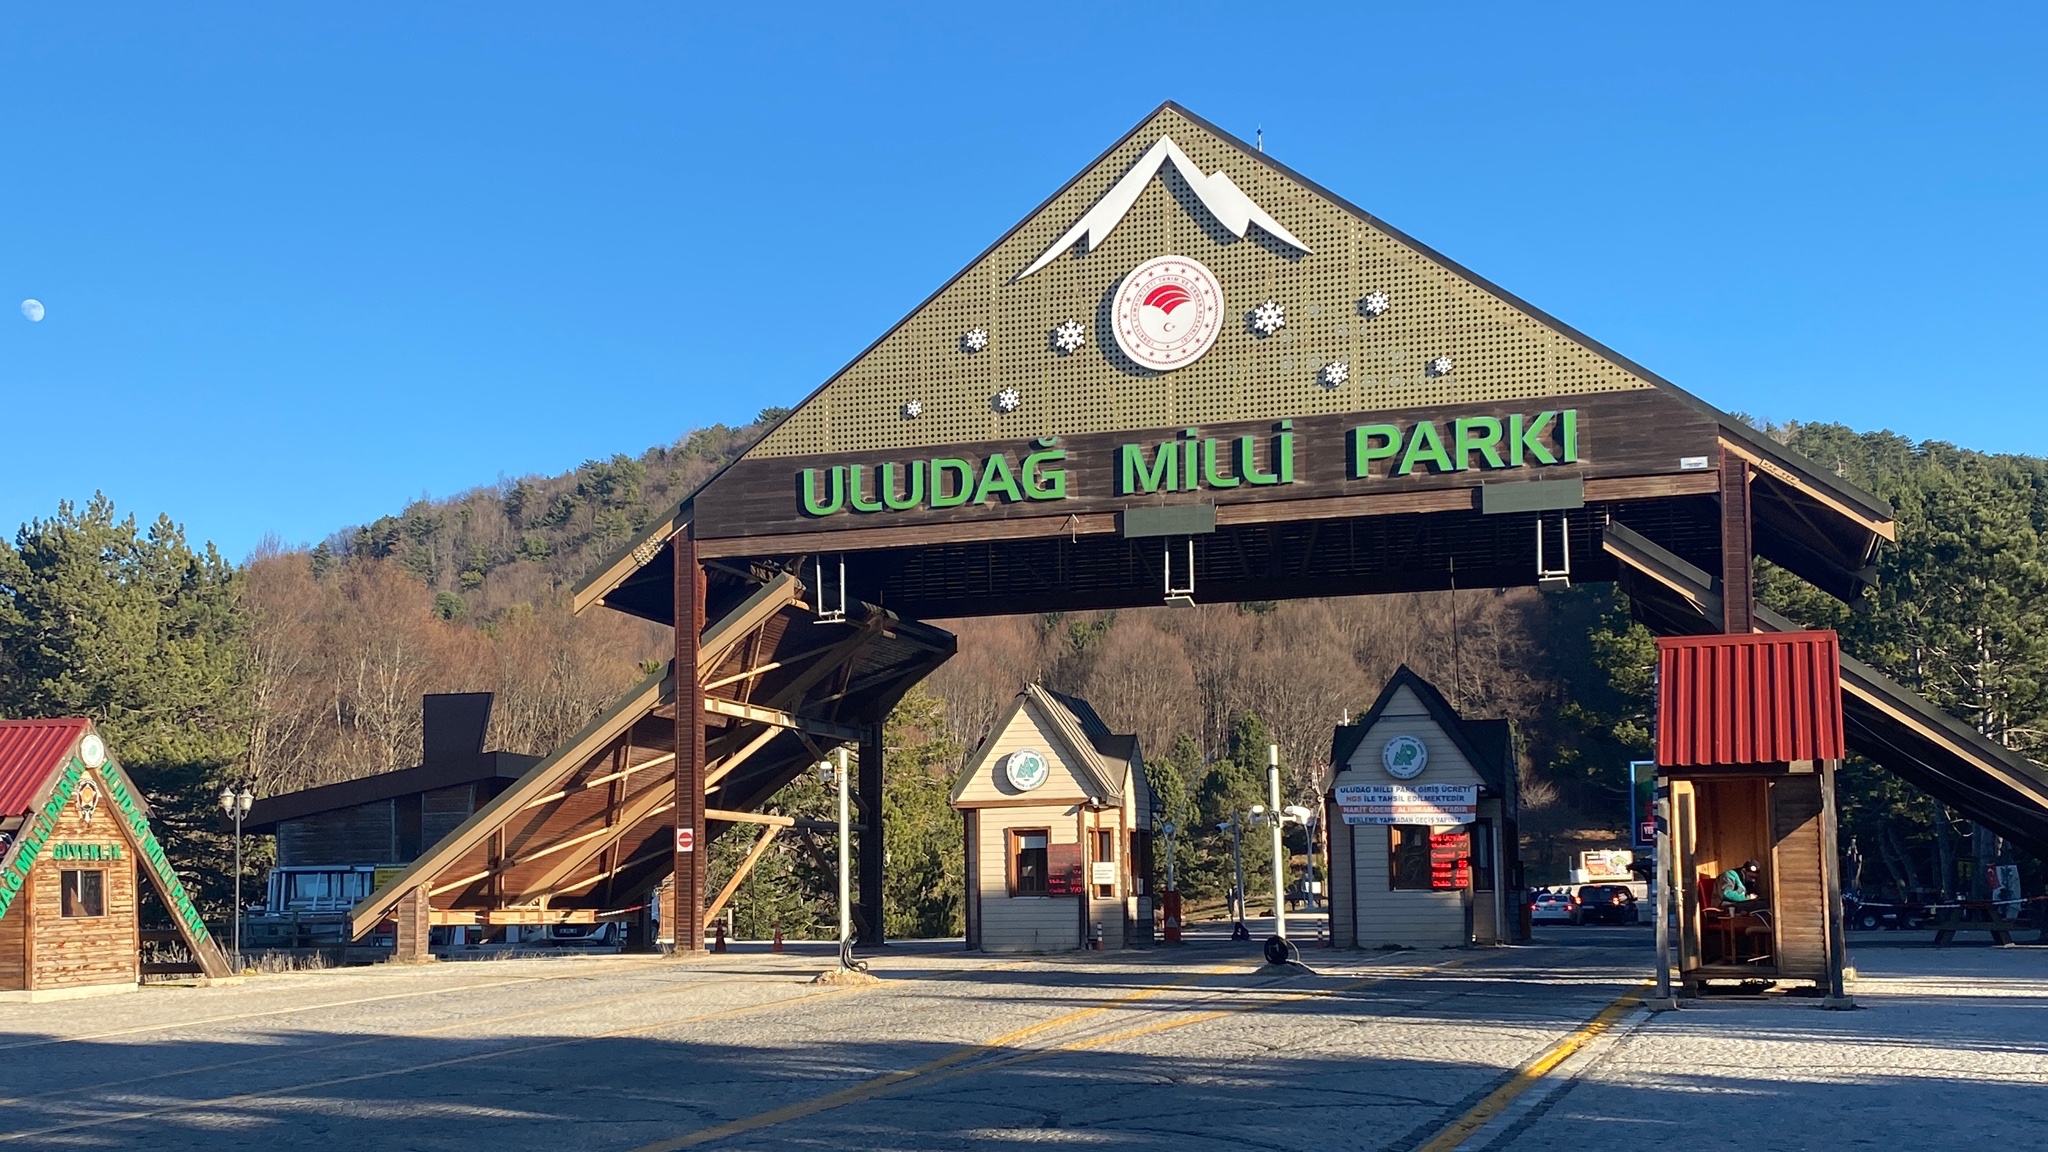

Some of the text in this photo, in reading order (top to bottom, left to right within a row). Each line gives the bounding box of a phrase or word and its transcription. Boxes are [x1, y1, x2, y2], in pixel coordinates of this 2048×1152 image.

[803, 409, 1578, 516] ULUDAĞ MİLLİ PARKI
[45, 756, 86, 821] PARKI
[1343, 805, 1366, 813] NAKİT
[53, 840, 121, 861] GÜVENLİK
[101, 760, 150, 838] ULUDAĞ
[172, 882, 209, 944] PARKI
